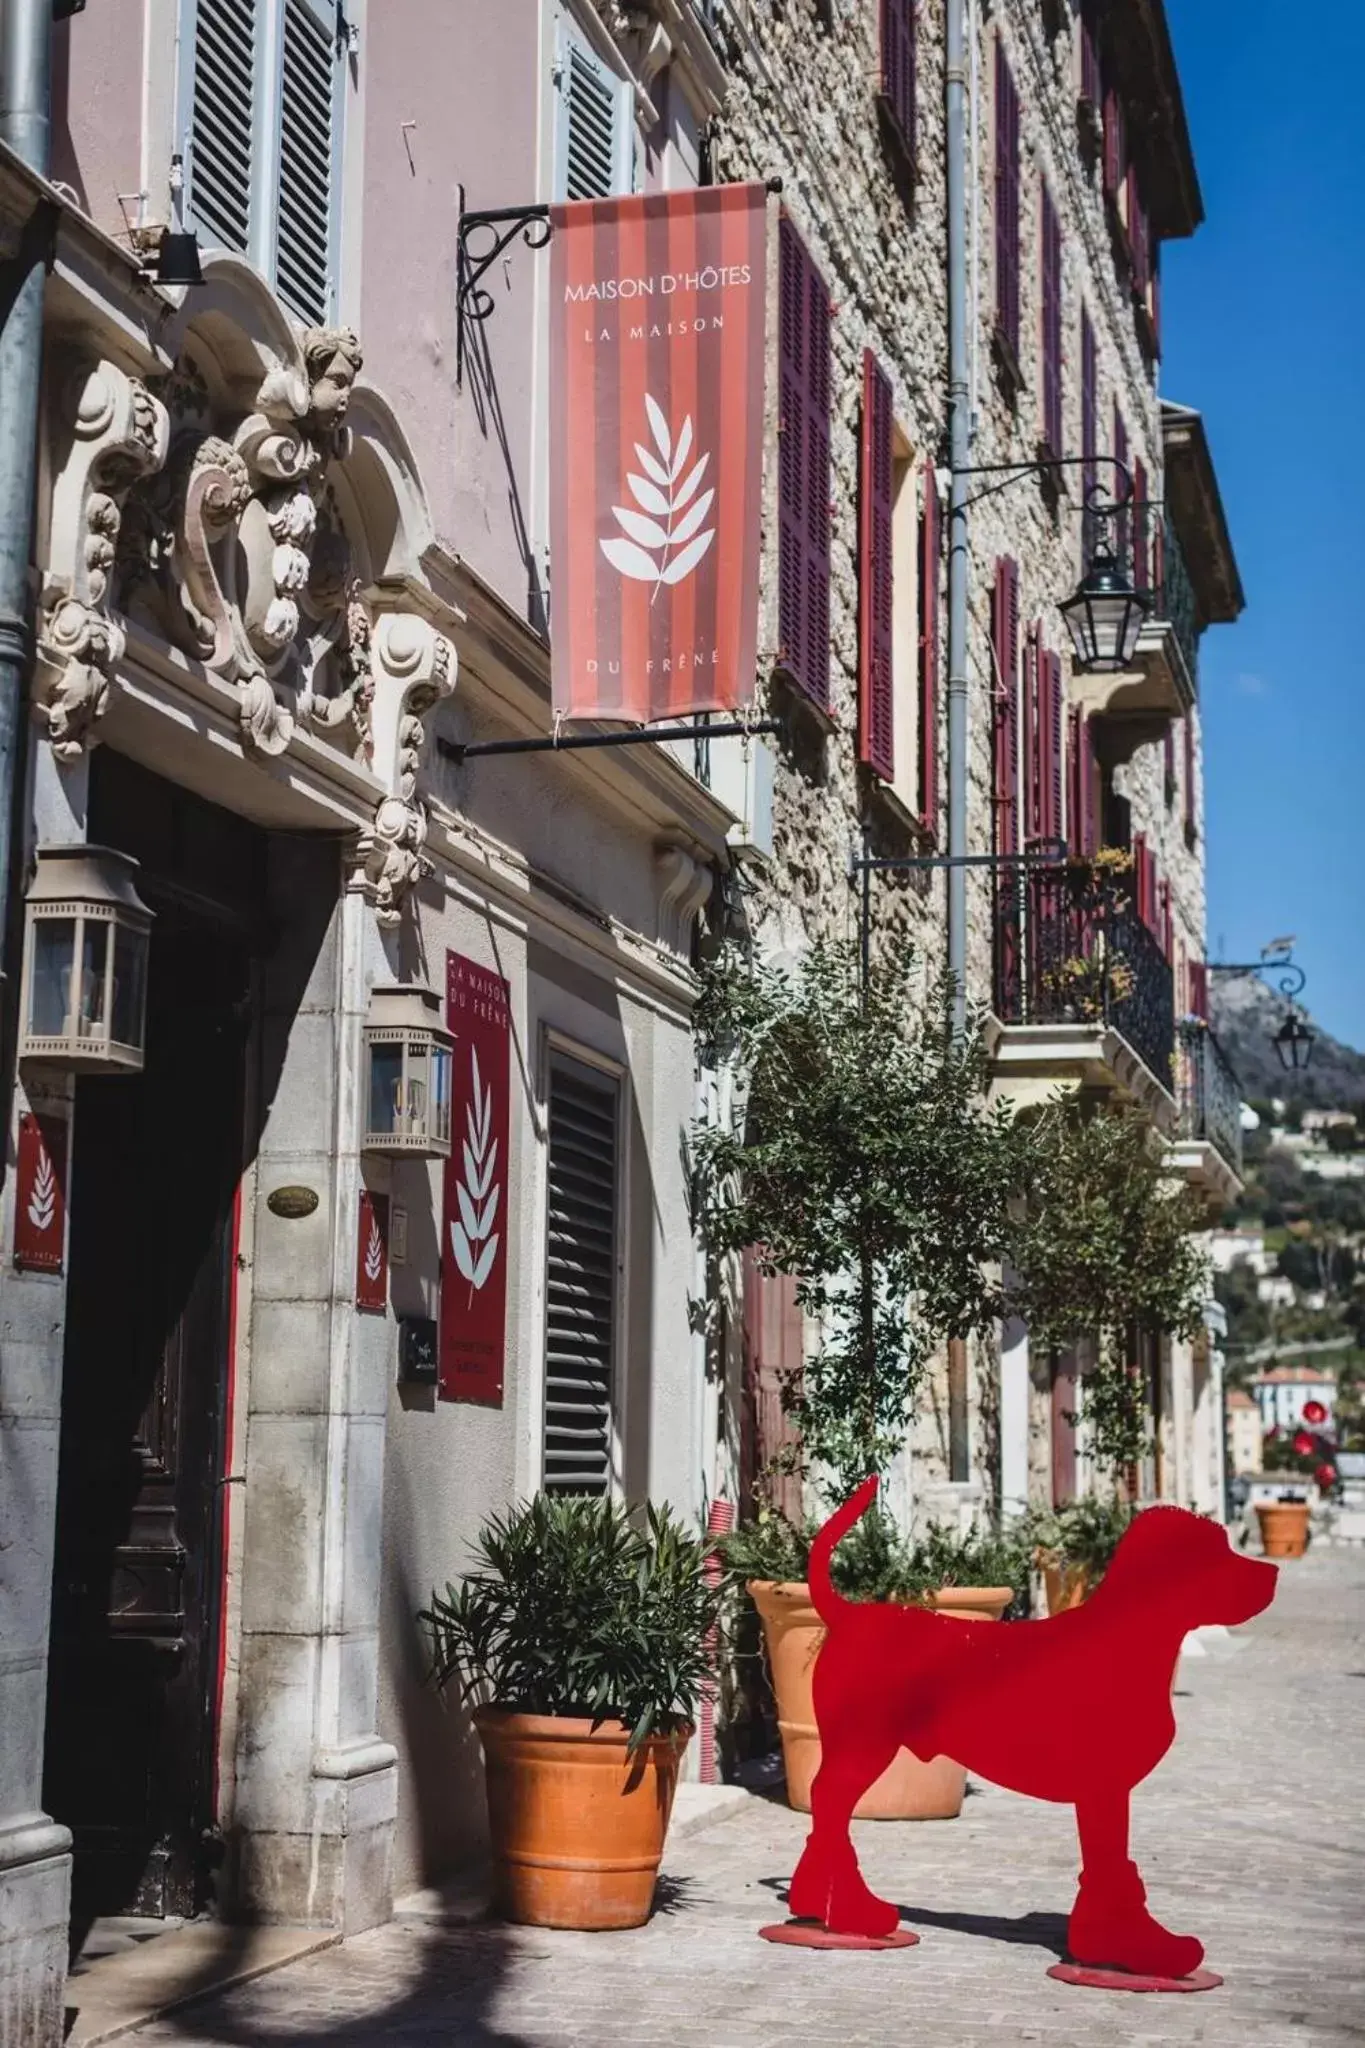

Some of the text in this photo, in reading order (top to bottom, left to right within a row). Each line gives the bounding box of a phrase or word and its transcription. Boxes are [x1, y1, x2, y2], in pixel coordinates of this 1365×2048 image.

[565, 264, 751, 303] MAISON D'HÔTES
[585, 316, 723, 342] LA MAISON
[586, 659, 620, 674] DU
[469, 972, 506, 1004] MAISON
